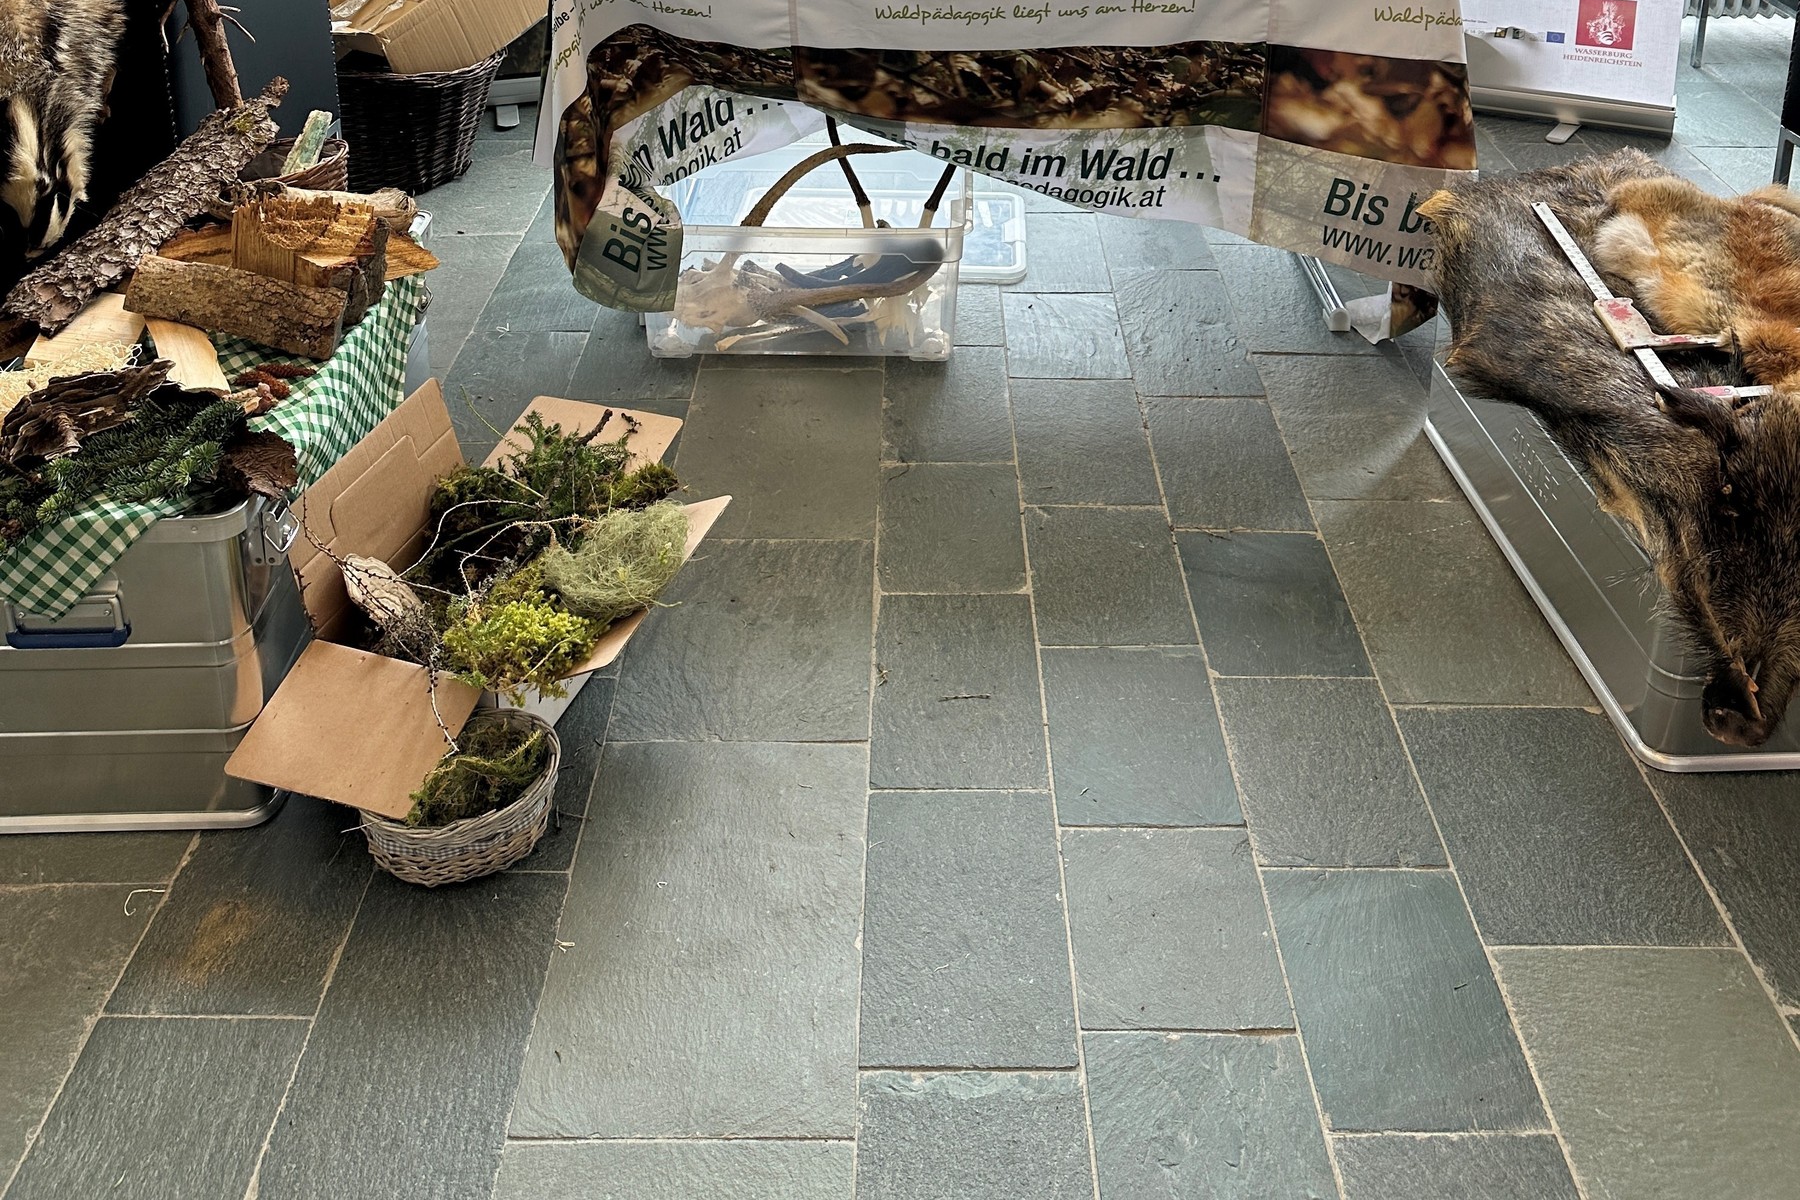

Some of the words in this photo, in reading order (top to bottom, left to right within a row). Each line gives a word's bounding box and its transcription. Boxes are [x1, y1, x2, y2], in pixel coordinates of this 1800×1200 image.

[652, 1, 712, 18] Herzen!
[874, 4, 1006, 26] Waldpädagogik
[1012, 2, 1052, 24] liegt
[1058, 4, 1090, 18] uns
[1094, 2, 1126, 16] am
[1563, 54, 1642, 68] HEIDENREICHSTEIN
[1575, 47, 1633, 60] WASSERBURG
[930, 140, 1010, 172] bald
[1020, 147, 1067, 178] im
[1323, 178, 1389, 226] Bis
[602, 207, 652, 274] Bis
